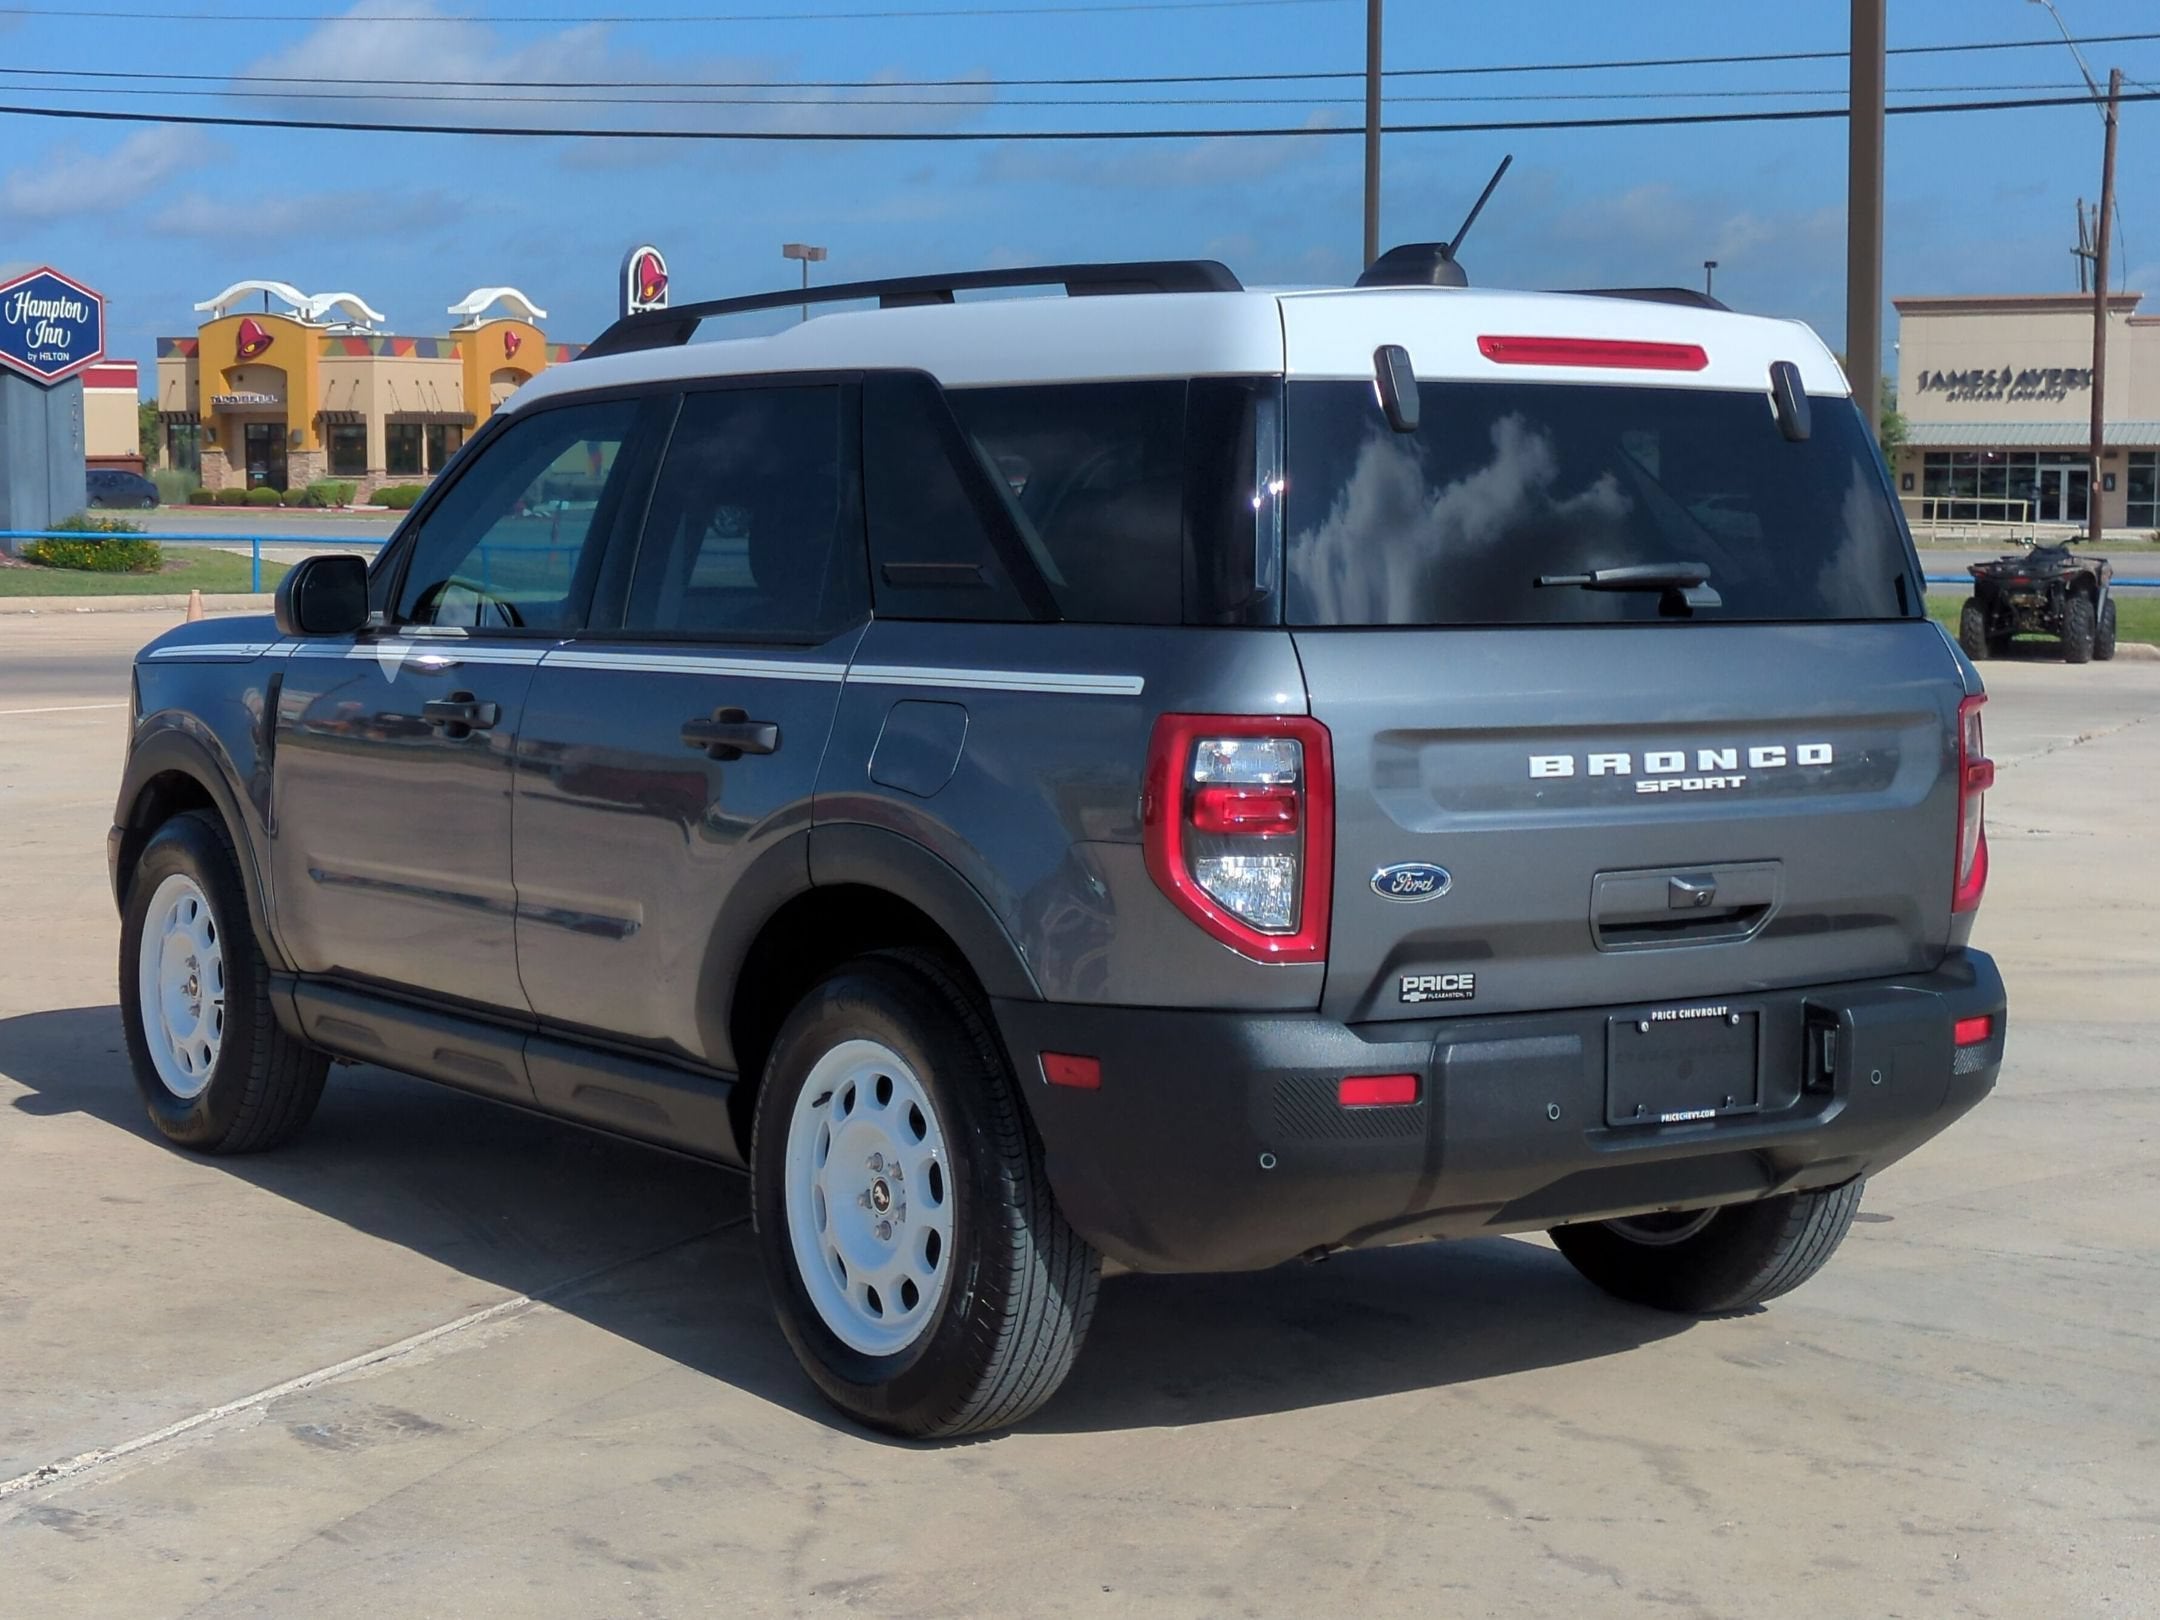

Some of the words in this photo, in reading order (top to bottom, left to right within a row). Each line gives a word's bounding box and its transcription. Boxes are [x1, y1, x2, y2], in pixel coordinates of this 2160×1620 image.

[5, 291, 88, 324] Hampton
[26, 319, 70, 348] Inn
[27, 352, 37, 362] by
[40, 352, 69, 360] HILTON
[1916, 369, 1998, 394] JAMES
[1529, 743, 1832, 778] BRONCO
[1636, 776, 1746, 793] SPORT
[1391, 871, 1434, 893] Ford
[1402, 974, 1474, 992] PRICE
[1651, 1010, 1677, 1021] PRICE
[1679, 1006, 1728, 1018] CHEVROLET
[1661, 1109, 1715, 1122] PRICECHEVY.COM
